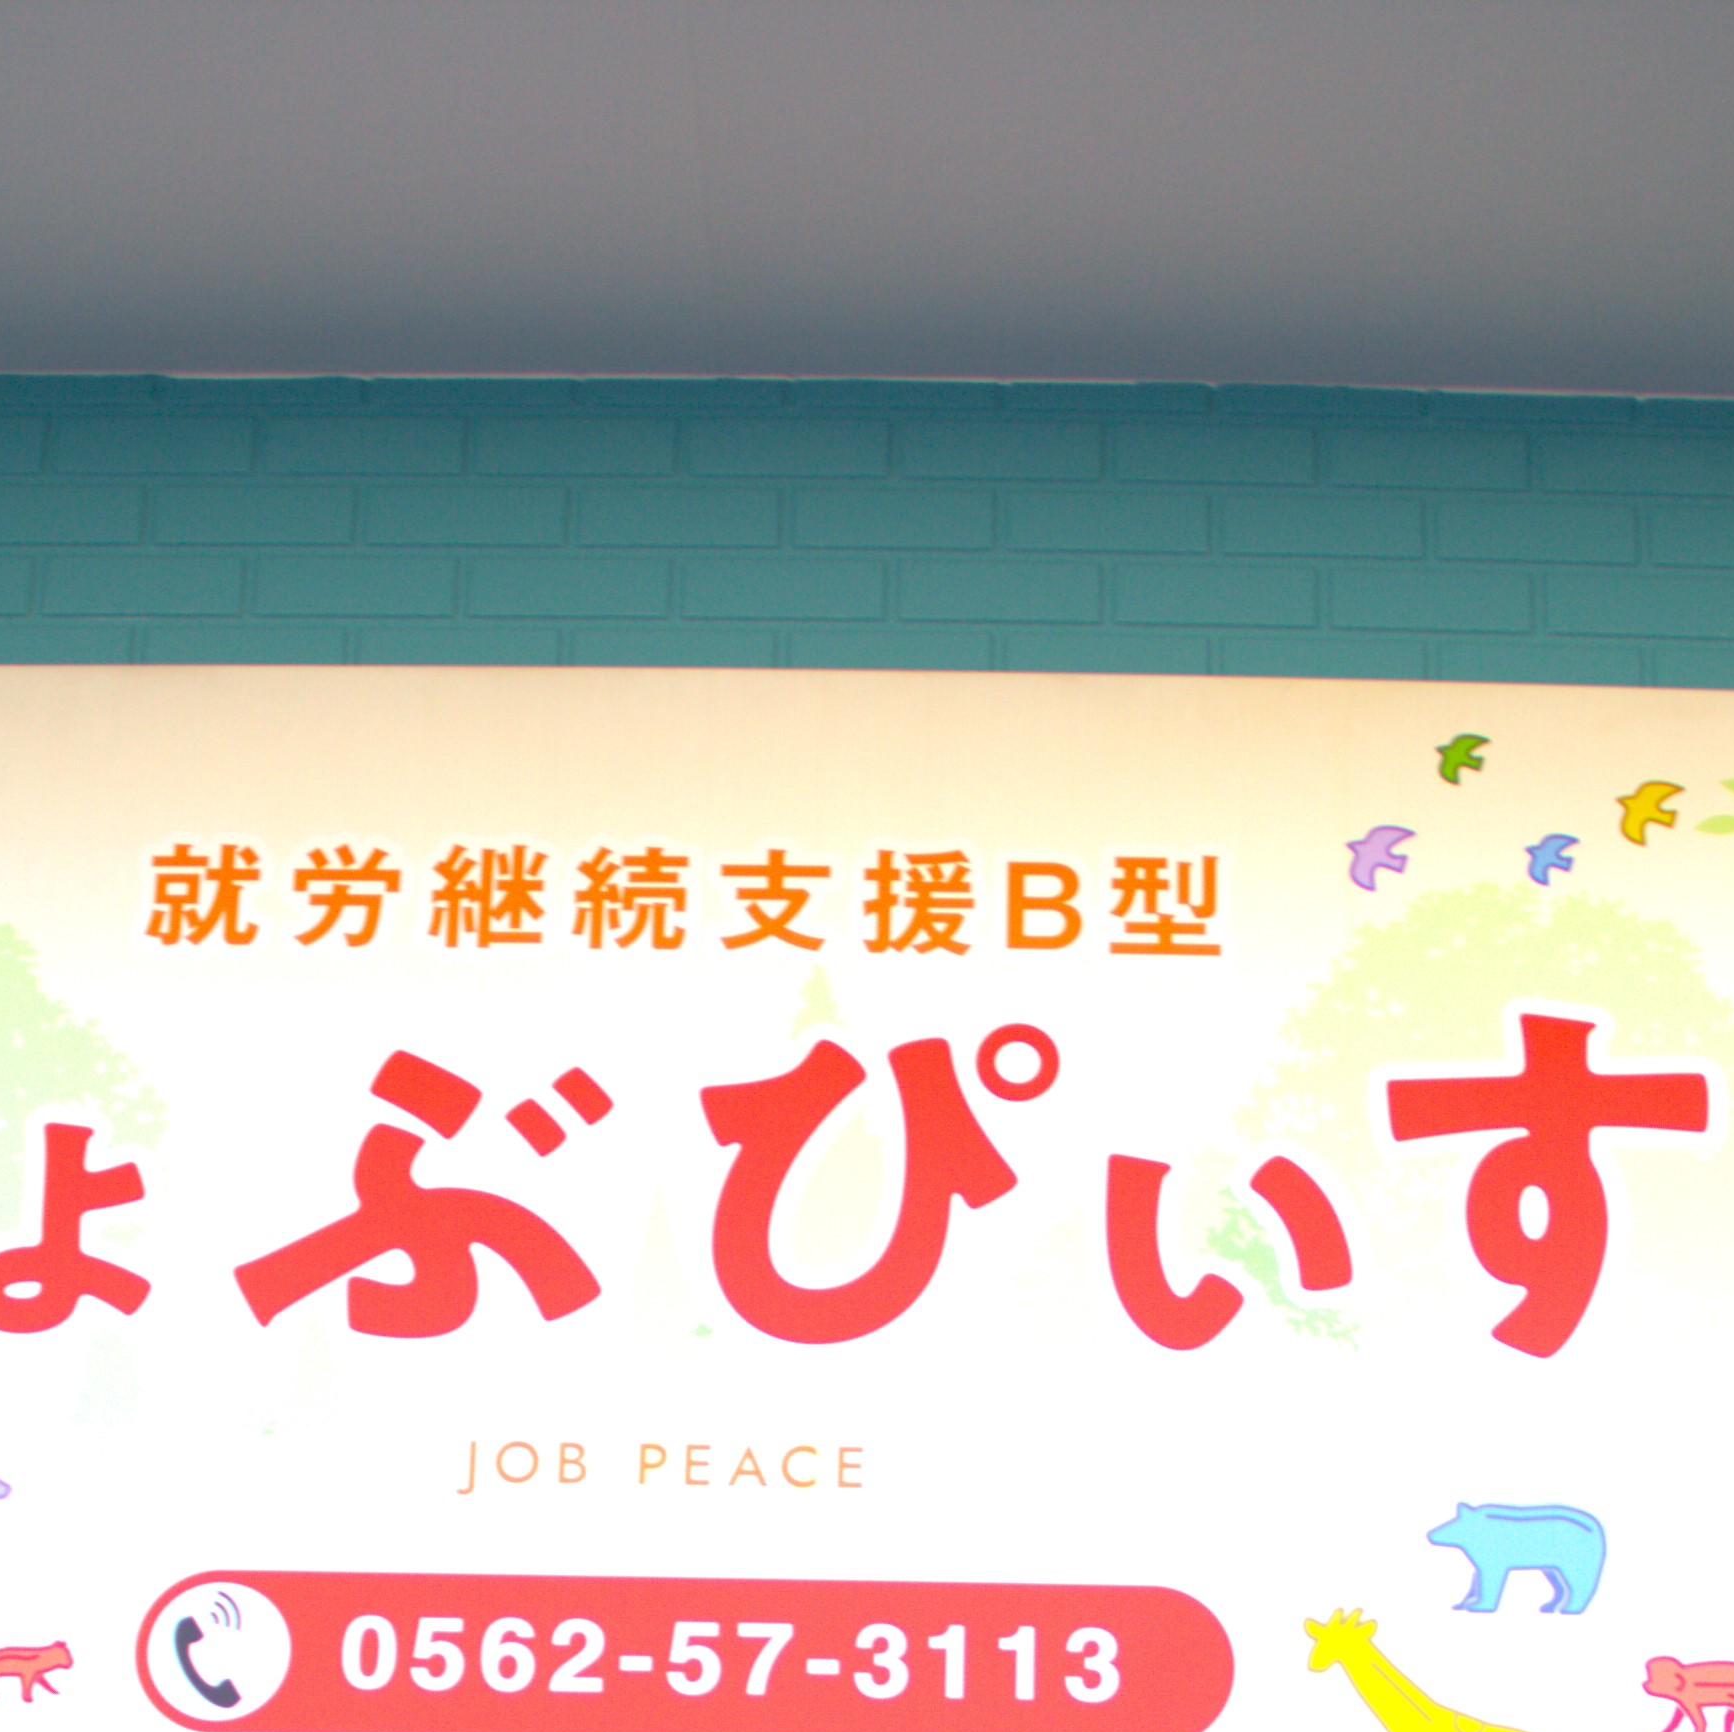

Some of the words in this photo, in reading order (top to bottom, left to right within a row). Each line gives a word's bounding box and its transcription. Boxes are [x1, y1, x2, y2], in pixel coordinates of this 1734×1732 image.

[146, 843, 1222, 957] 就労継続支援B型
[457, 1440, 588, 1495] JOB
[638, 1441, 865, 1490] PEACE
[340, 1613, 1121, 1704] 0562-57-3113
